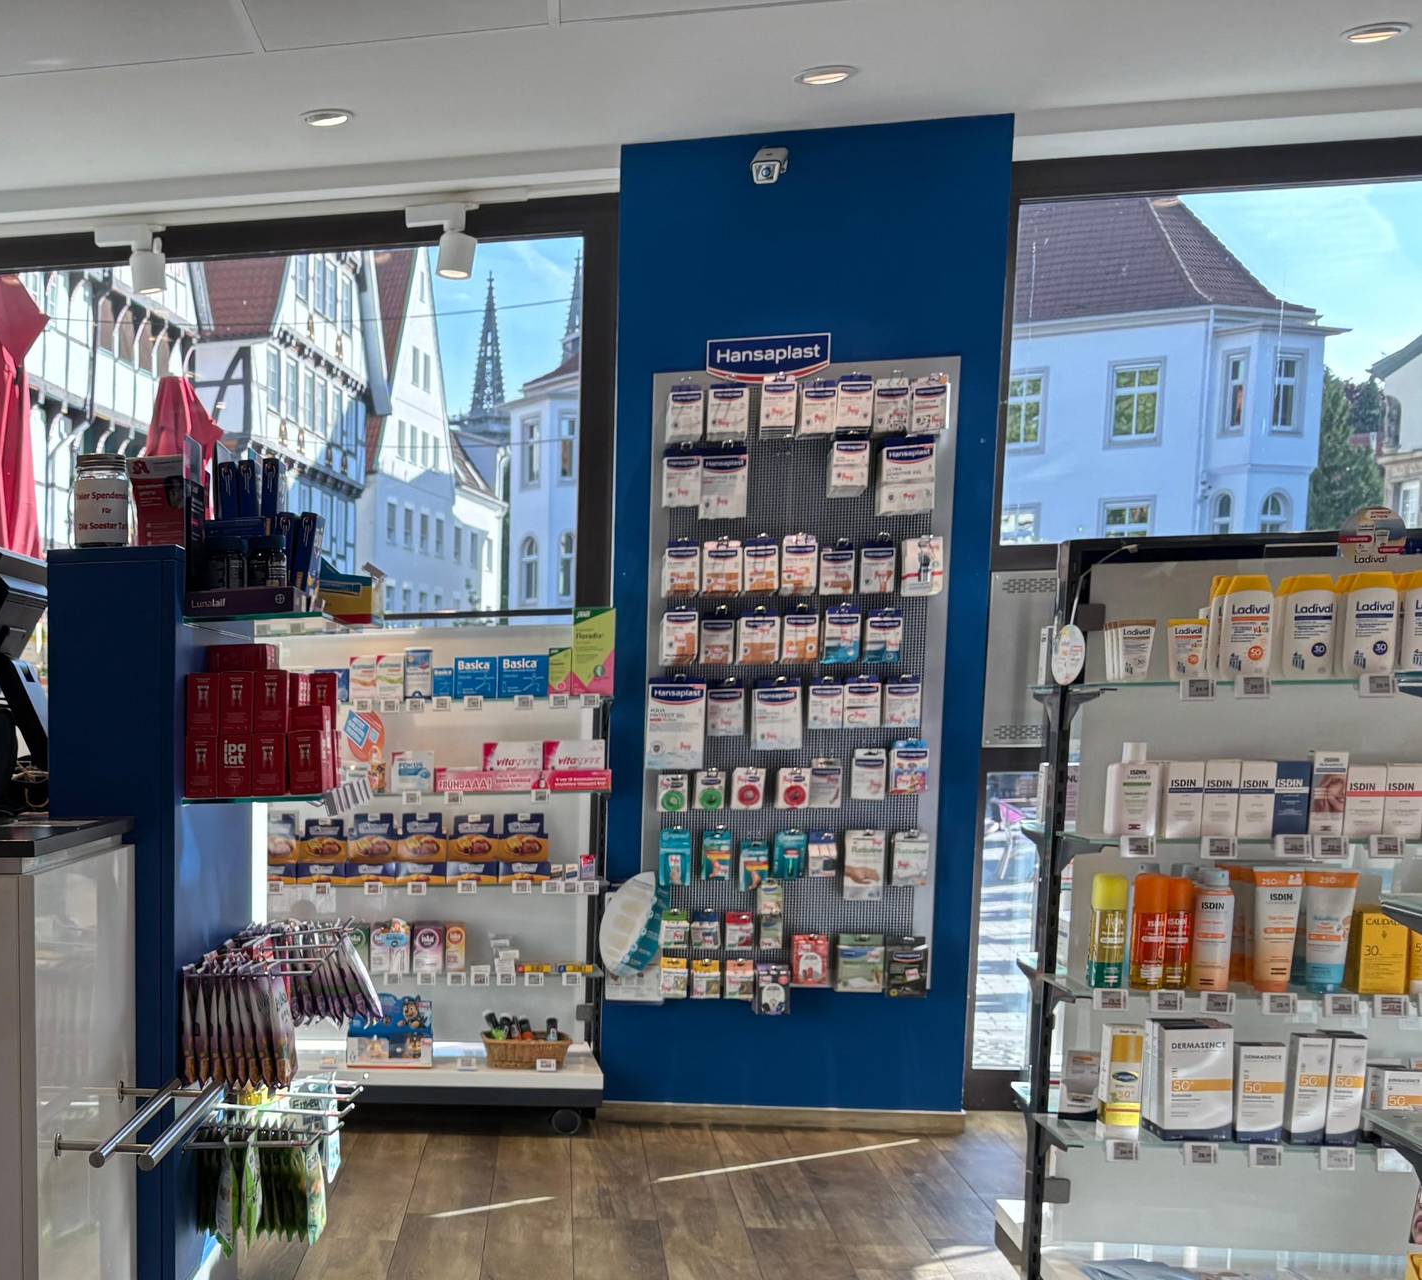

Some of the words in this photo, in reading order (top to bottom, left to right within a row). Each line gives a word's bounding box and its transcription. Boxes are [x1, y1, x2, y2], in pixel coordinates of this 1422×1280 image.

[716, 343, 821, 365] Hansaplast
[1354, 555, 1388, 564] Ladival
[1232, 604, 1271, 615] Ladival
[1295, 603, 1334, 614] Ladival
[1356, 601, 1395, 612] Ladival
[1123, 627, 1151, 636] Ladival
[1175, 626, 1203, 636] Ladival
[457, 660, 491, 671] Basica
[503, 658, 538, 670] Basica
[653, 688, 702, 699] Hansaplast
[1170, 778, 1197, 788] ISDIN
[1206, 779, 1233, 788] ISDIN
[1243, 779, 1269, 788] ISDIN
[1275, 778, 1304, 788] ISDIN
[1349, 782, 1376, 792] ISDIN
[1387, 782, 1415, 791] ISDIN
[1269, 893, 1293, 901] ISDIN
[1201, 901, 1225, 910] ISDIN
[1364, 944, 1379, 956] 30
[1171, 1041, 1227, 1050] DERMASENCE
